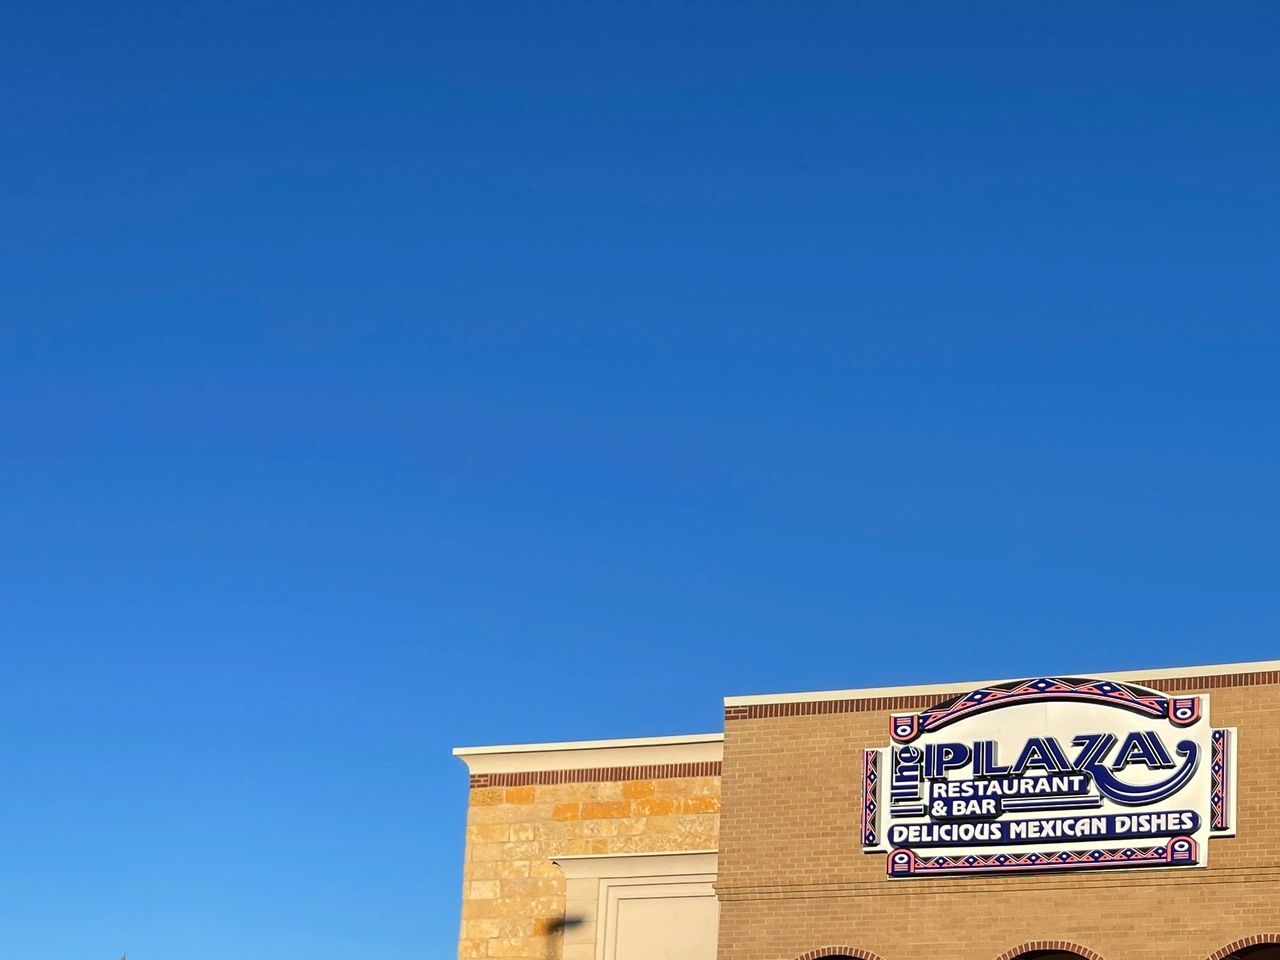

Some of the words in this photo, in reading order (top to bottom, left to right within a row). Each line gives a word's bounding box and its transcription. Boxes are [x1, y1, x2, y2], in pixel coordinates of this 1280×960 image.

[924, 731, 1199, 804] PLAZA
[932, 775, 1085, 799] RESTAURANT
[931, 799, 948, 817] &
[952, 798, 996, 816] BAR
[893, 823, 1002, 843] DELICIOUS
[1009, 817, 1109, 839] MEXICAN
[1115, 811, 1194, 835] DISHES
